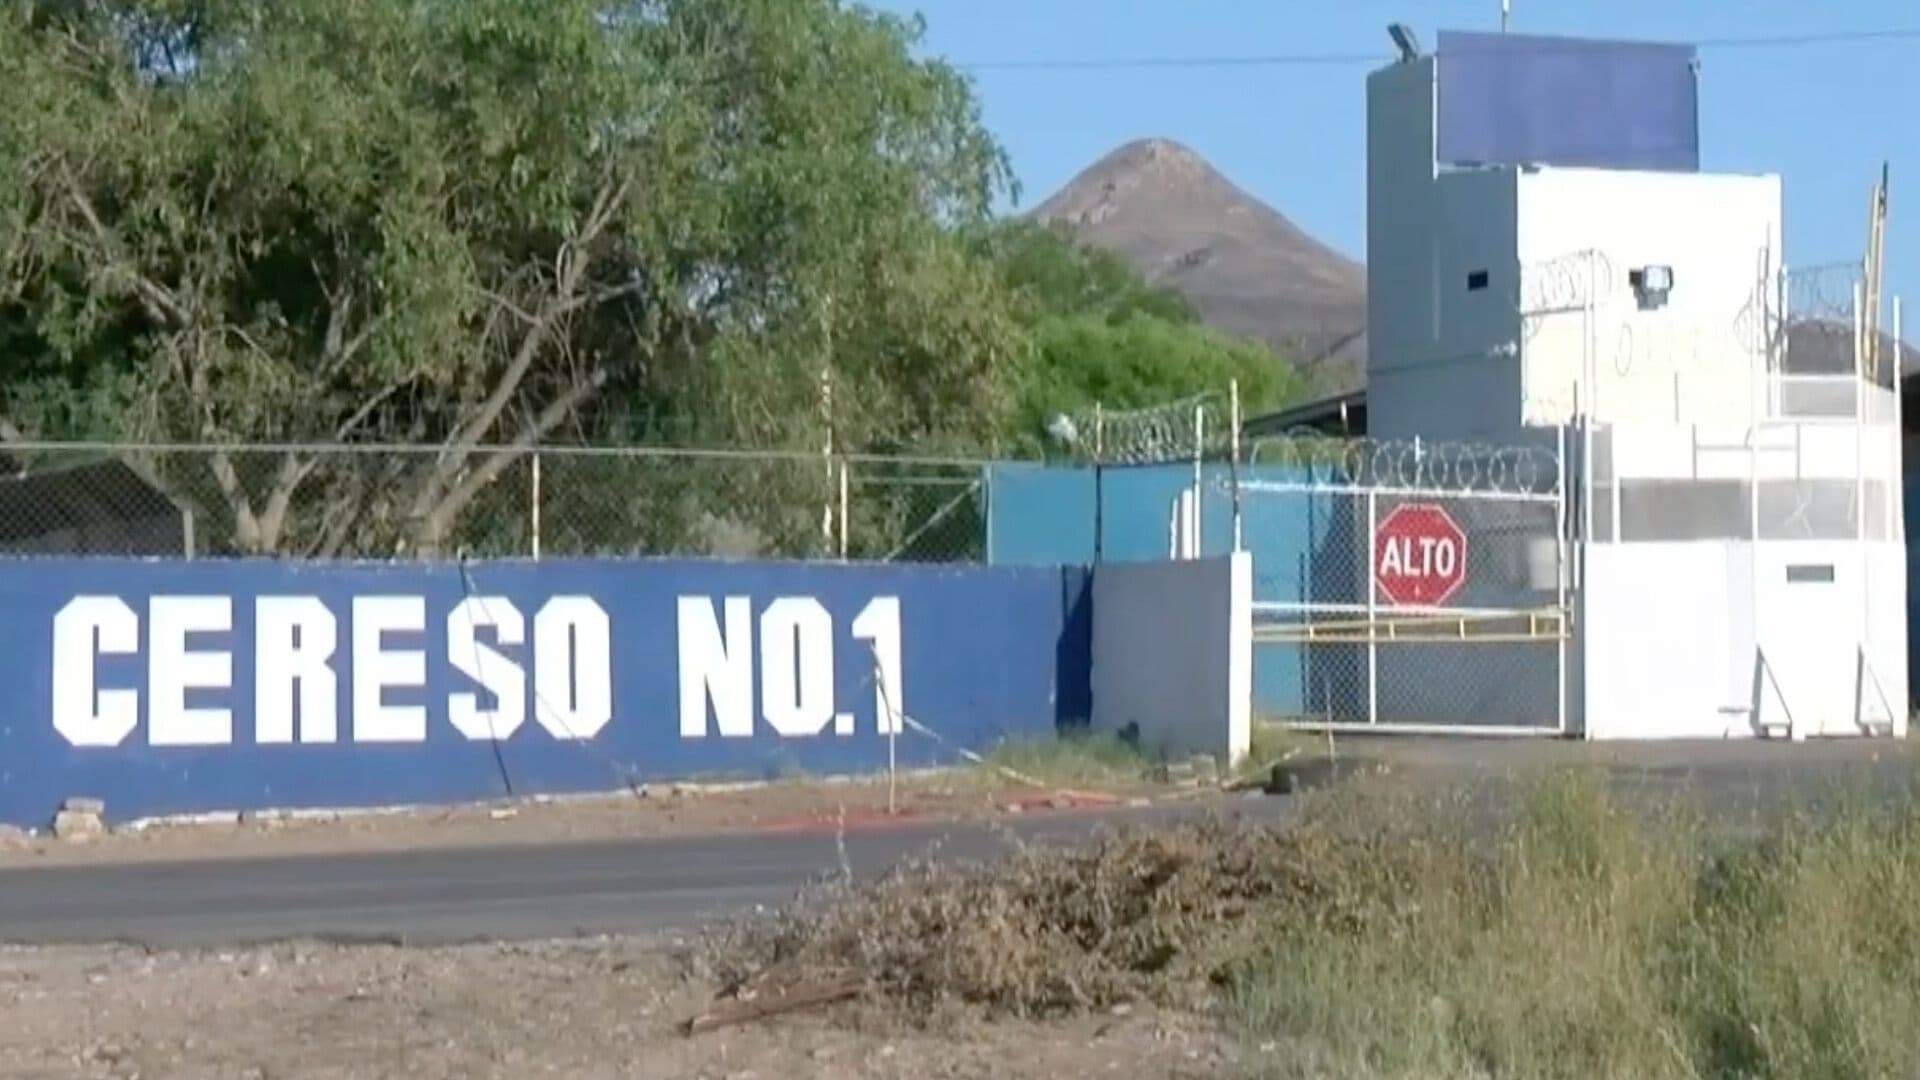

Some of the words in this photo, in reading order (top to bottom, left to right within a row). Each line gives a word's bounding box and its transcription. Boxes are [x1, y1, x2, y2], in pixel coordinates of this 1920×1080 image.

[1380, 537, 1455, 577] ALTO
[53, 595, 612, 747] CERESO
[677, 596, 903, 738] NO.1
